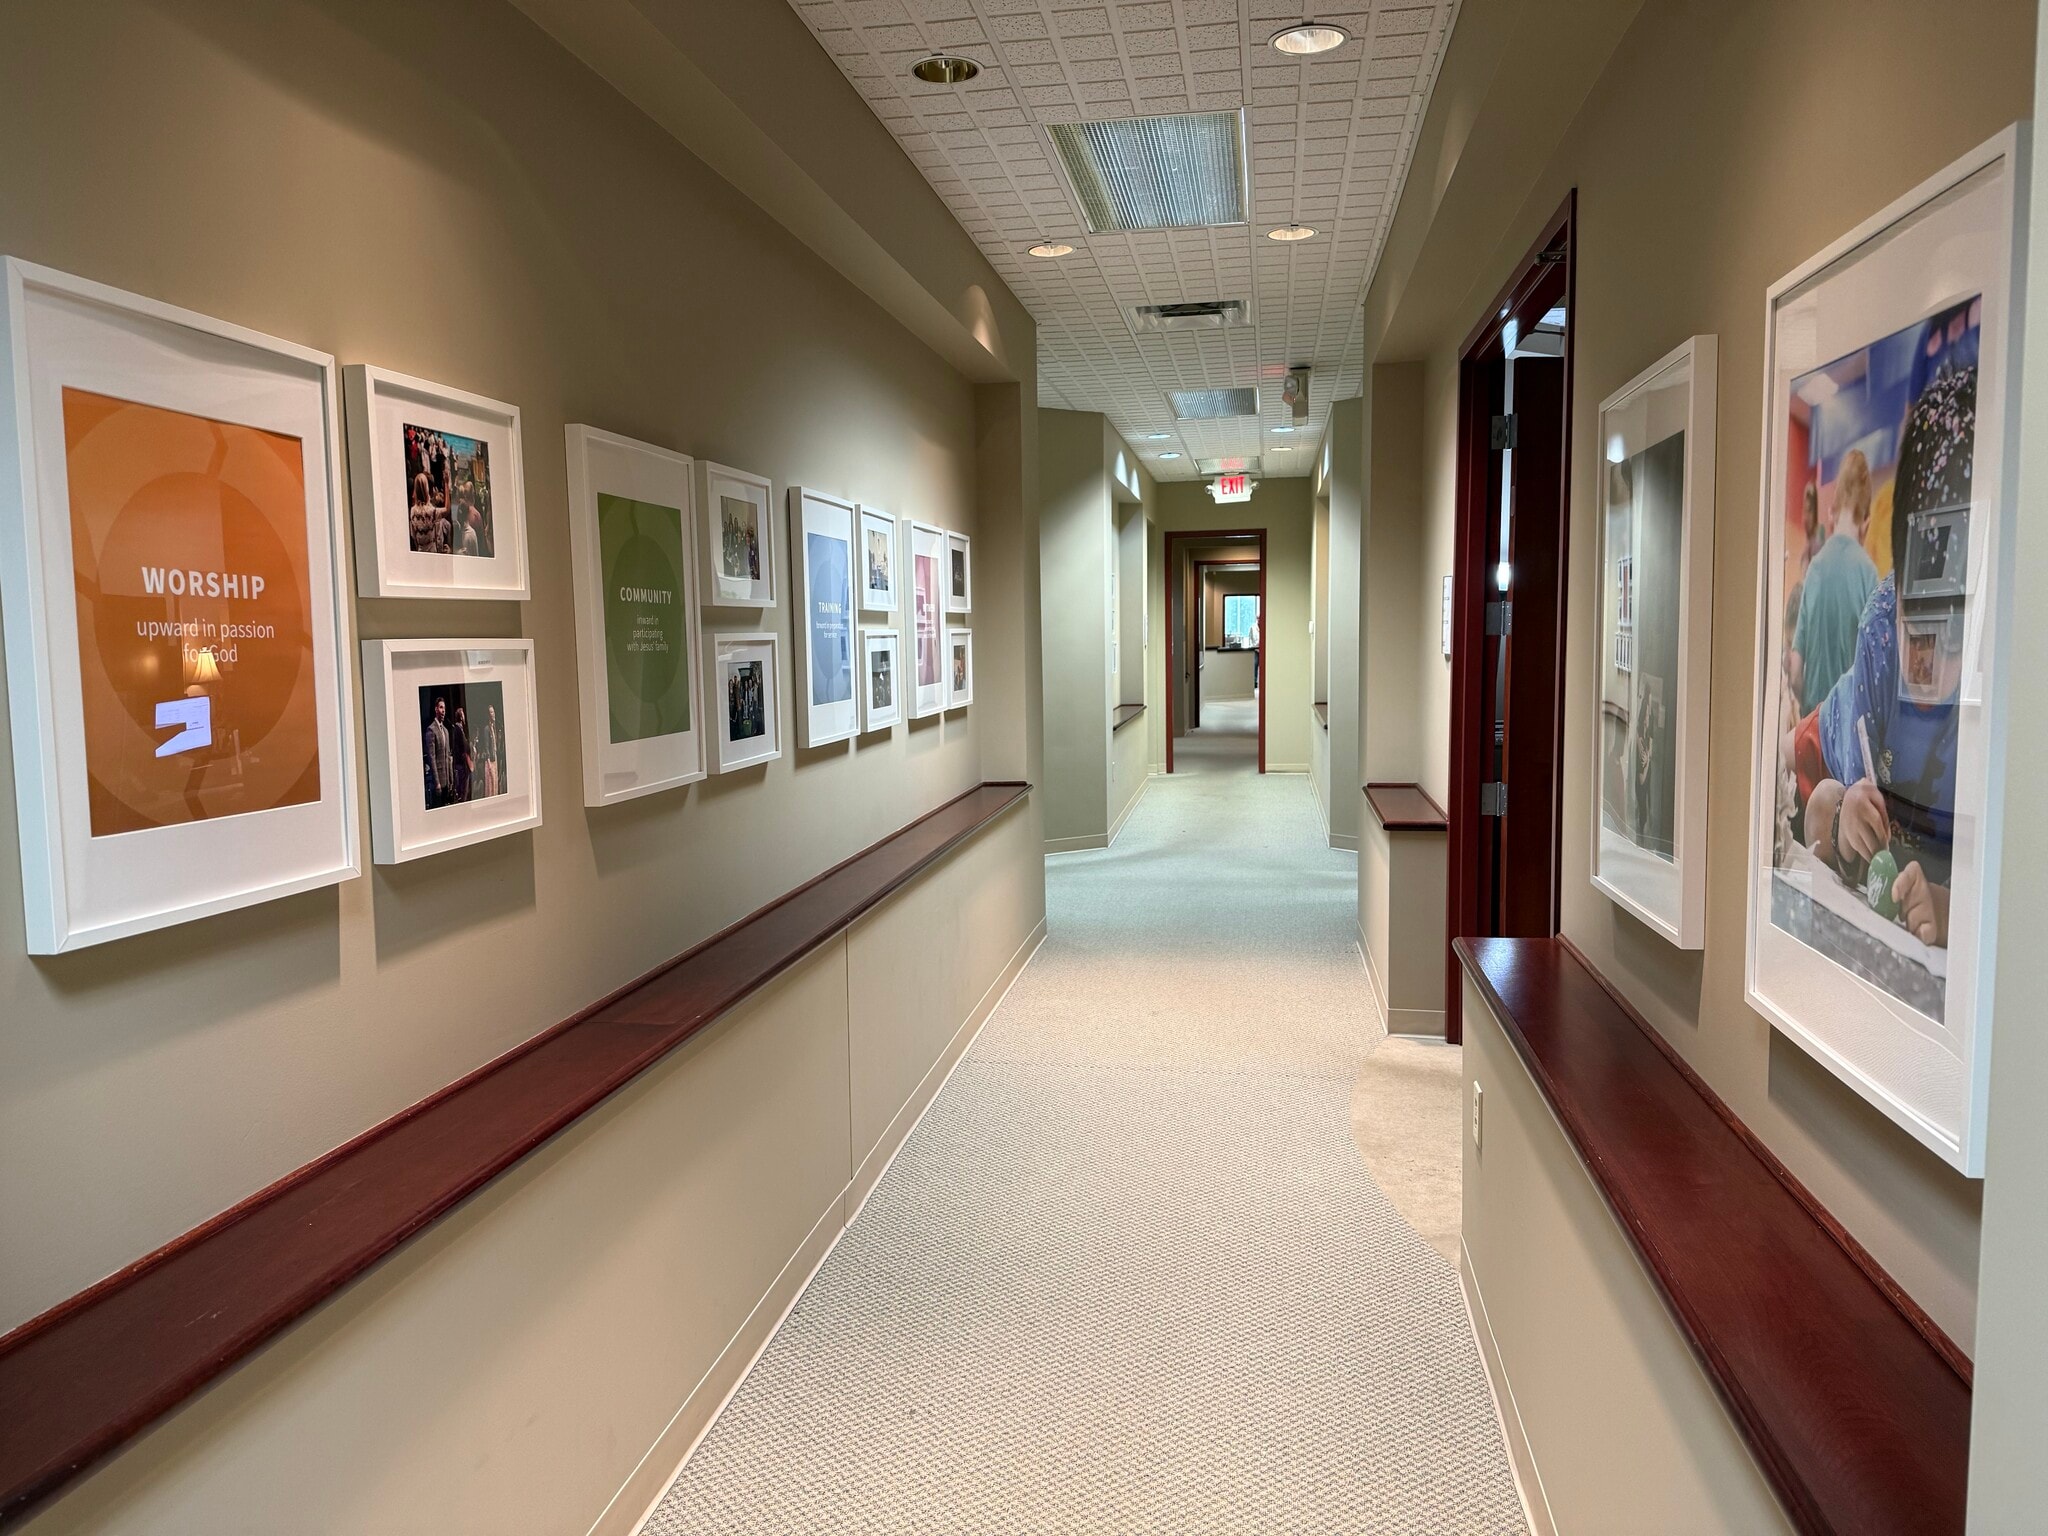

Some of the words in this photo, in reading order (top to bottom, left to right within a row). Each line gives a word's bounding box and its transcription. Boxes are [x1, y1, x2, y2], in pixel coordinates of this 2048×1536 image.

[1221, 476, 1245, 495] EXIT
[141, 566, 265, 600] WORSHIP
[620, 586, 672, 605] COMMUNITY
[818, 601, 842, 614] TRAINING
[137, 618, 198, 641] upward
[202, 618, 216, 637] in
[220, 620, 274, 642] passion
[632, 627, 664, 641] participating
[209, 643, 238, 663] God
[627, 640, 640, 652] with
